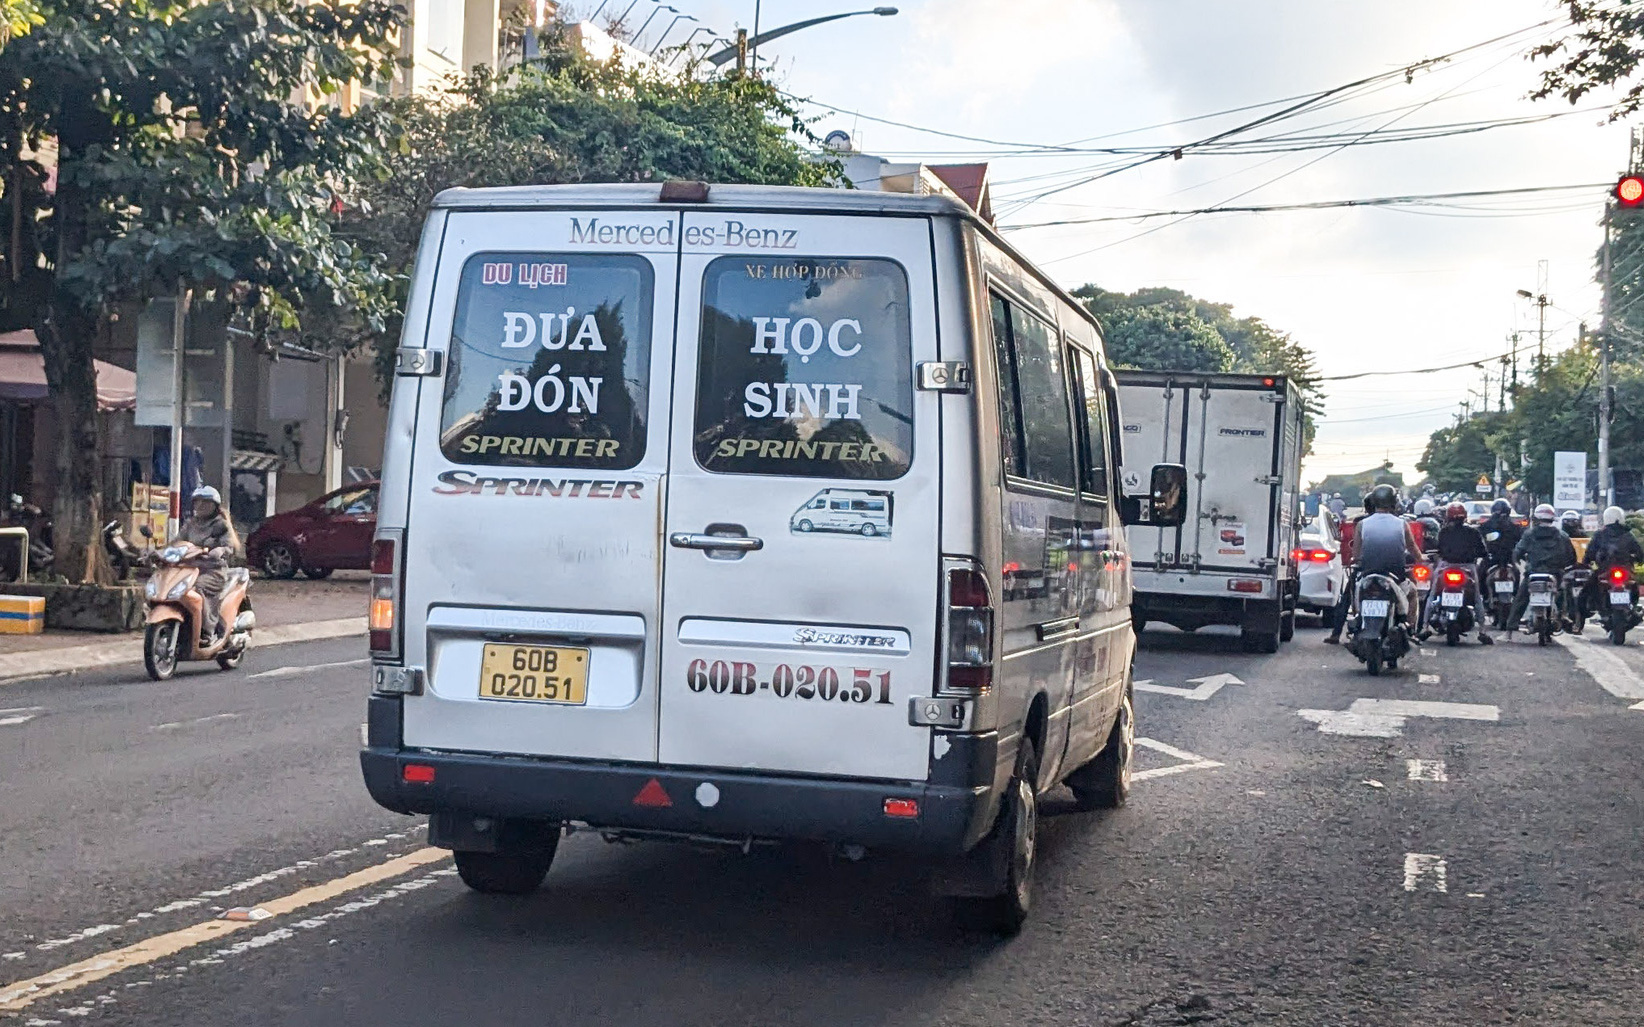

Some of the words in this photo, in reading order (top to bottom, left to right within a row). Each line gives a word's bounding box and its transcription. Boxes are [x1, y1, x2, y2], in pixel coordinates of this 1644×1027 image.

[569, 217, 798, 249] Mercedes-Benz
[483, 263, 512, 285] DU
[519, 263, 567, 288] LỊCH
[746, 264, 767, 279] XE
[772, 263, 809, 281] HỢP
[501, 306, 607, 351] ĐƯA
[750, 317, 862, 363] HỌC
[497, 363, 603, 414] ĐÓN
[743, 381, 862, 419] SINH
[1220, 428, 1265, 436] FRONTIER
[460, 435, 620, 457] SPRINTER
[717, 438, 886, 462] SPRINTER
[431, 470, 644, 499] SPRINTER
[793, 627, 896, 648] SPRINTER
[512, 648, 558, 673] 60B
[491, 673, 572, 700] 020.51
[687, 658, 894, 705] 60B-020.51
